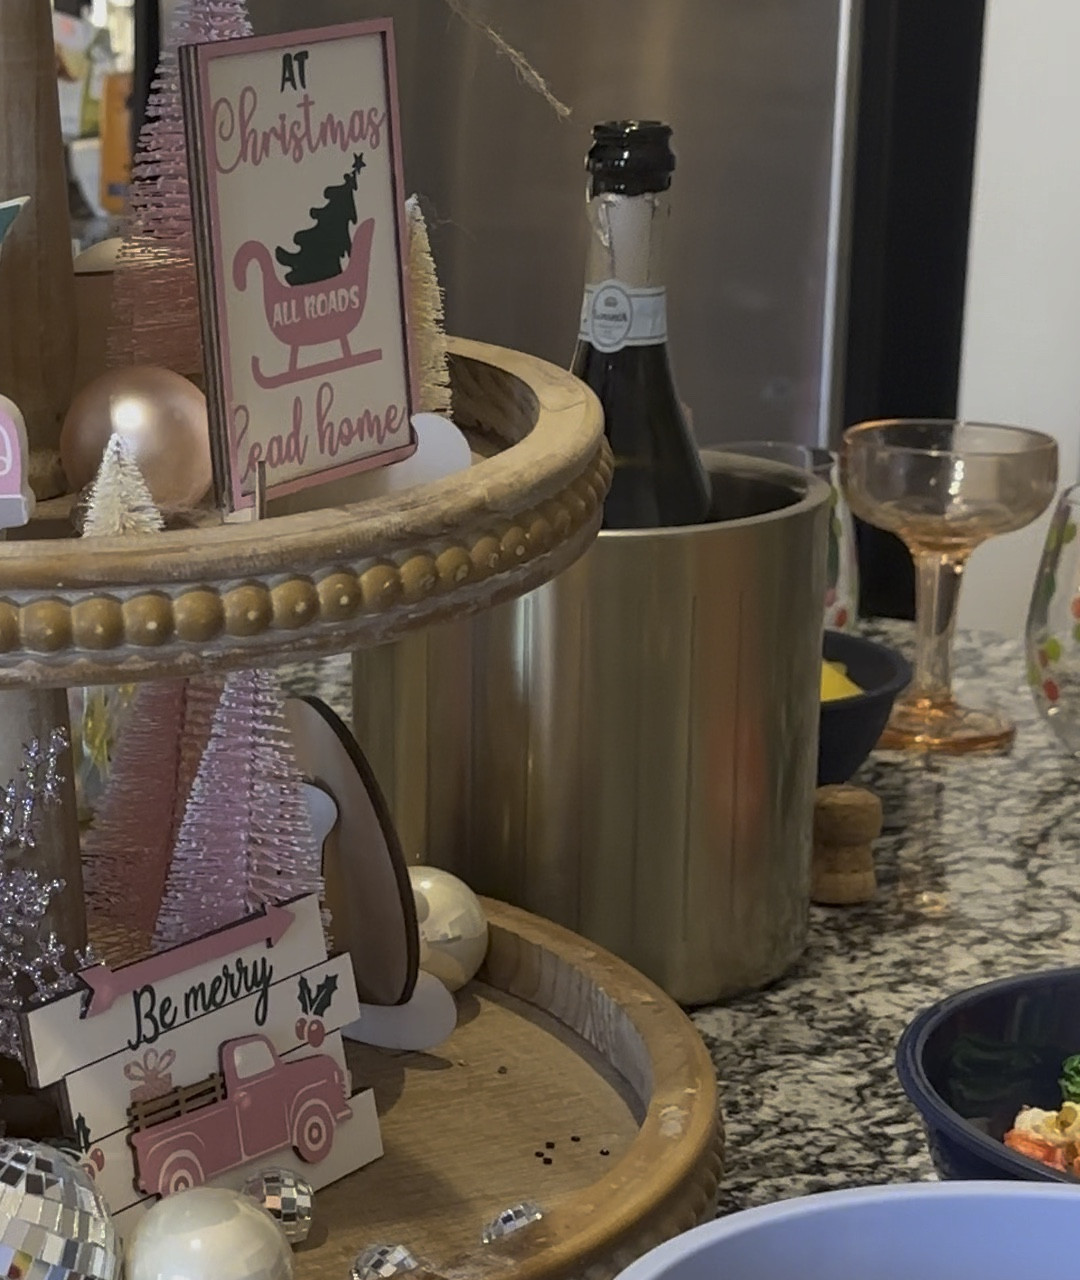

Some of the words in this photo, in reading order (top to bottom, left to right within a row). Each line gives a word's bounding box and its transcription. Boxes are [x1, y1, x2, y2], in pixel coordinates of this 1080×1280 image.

[280, 51, 309, 93] AT
[212, 85, 387, 175] Christmas
[272, 295, 301, 328] ALL
[304, 285, 360, 321] ROADS
[318, 382, 407, 457] home
[126, 984, 177, 1051] Be
[183, 956, 273, 1026] merry
